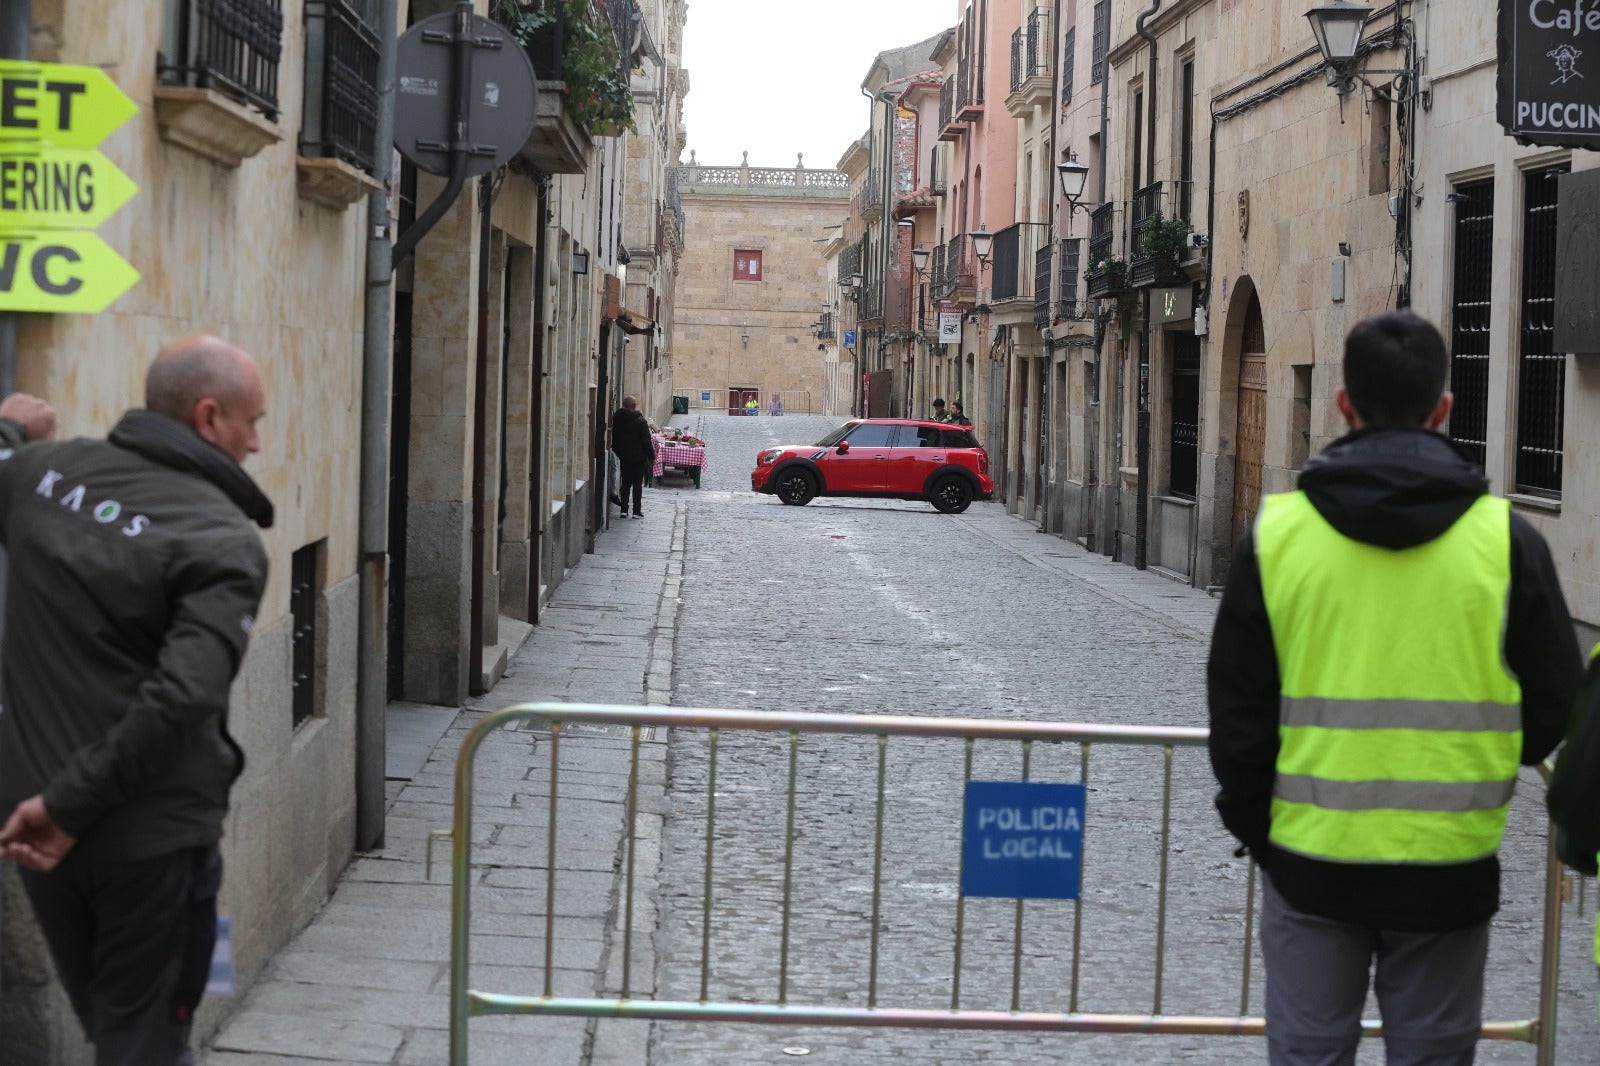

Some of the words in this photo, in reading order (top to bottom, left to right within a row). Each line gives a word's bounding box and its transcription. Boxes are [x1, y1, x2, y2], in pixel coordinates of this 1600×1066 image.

[1529, 0, 1600, 37] Café
[1, 78, 87, 131] ET
[1517, 101, 1600, 129] PUCCIN
[1, 161, 94, 213] ERING
[36, 469, 150, 537] KAOS
[978, 807, 1080, 831] POLICIA
[983, 836, 1073, 859] LOCAL
